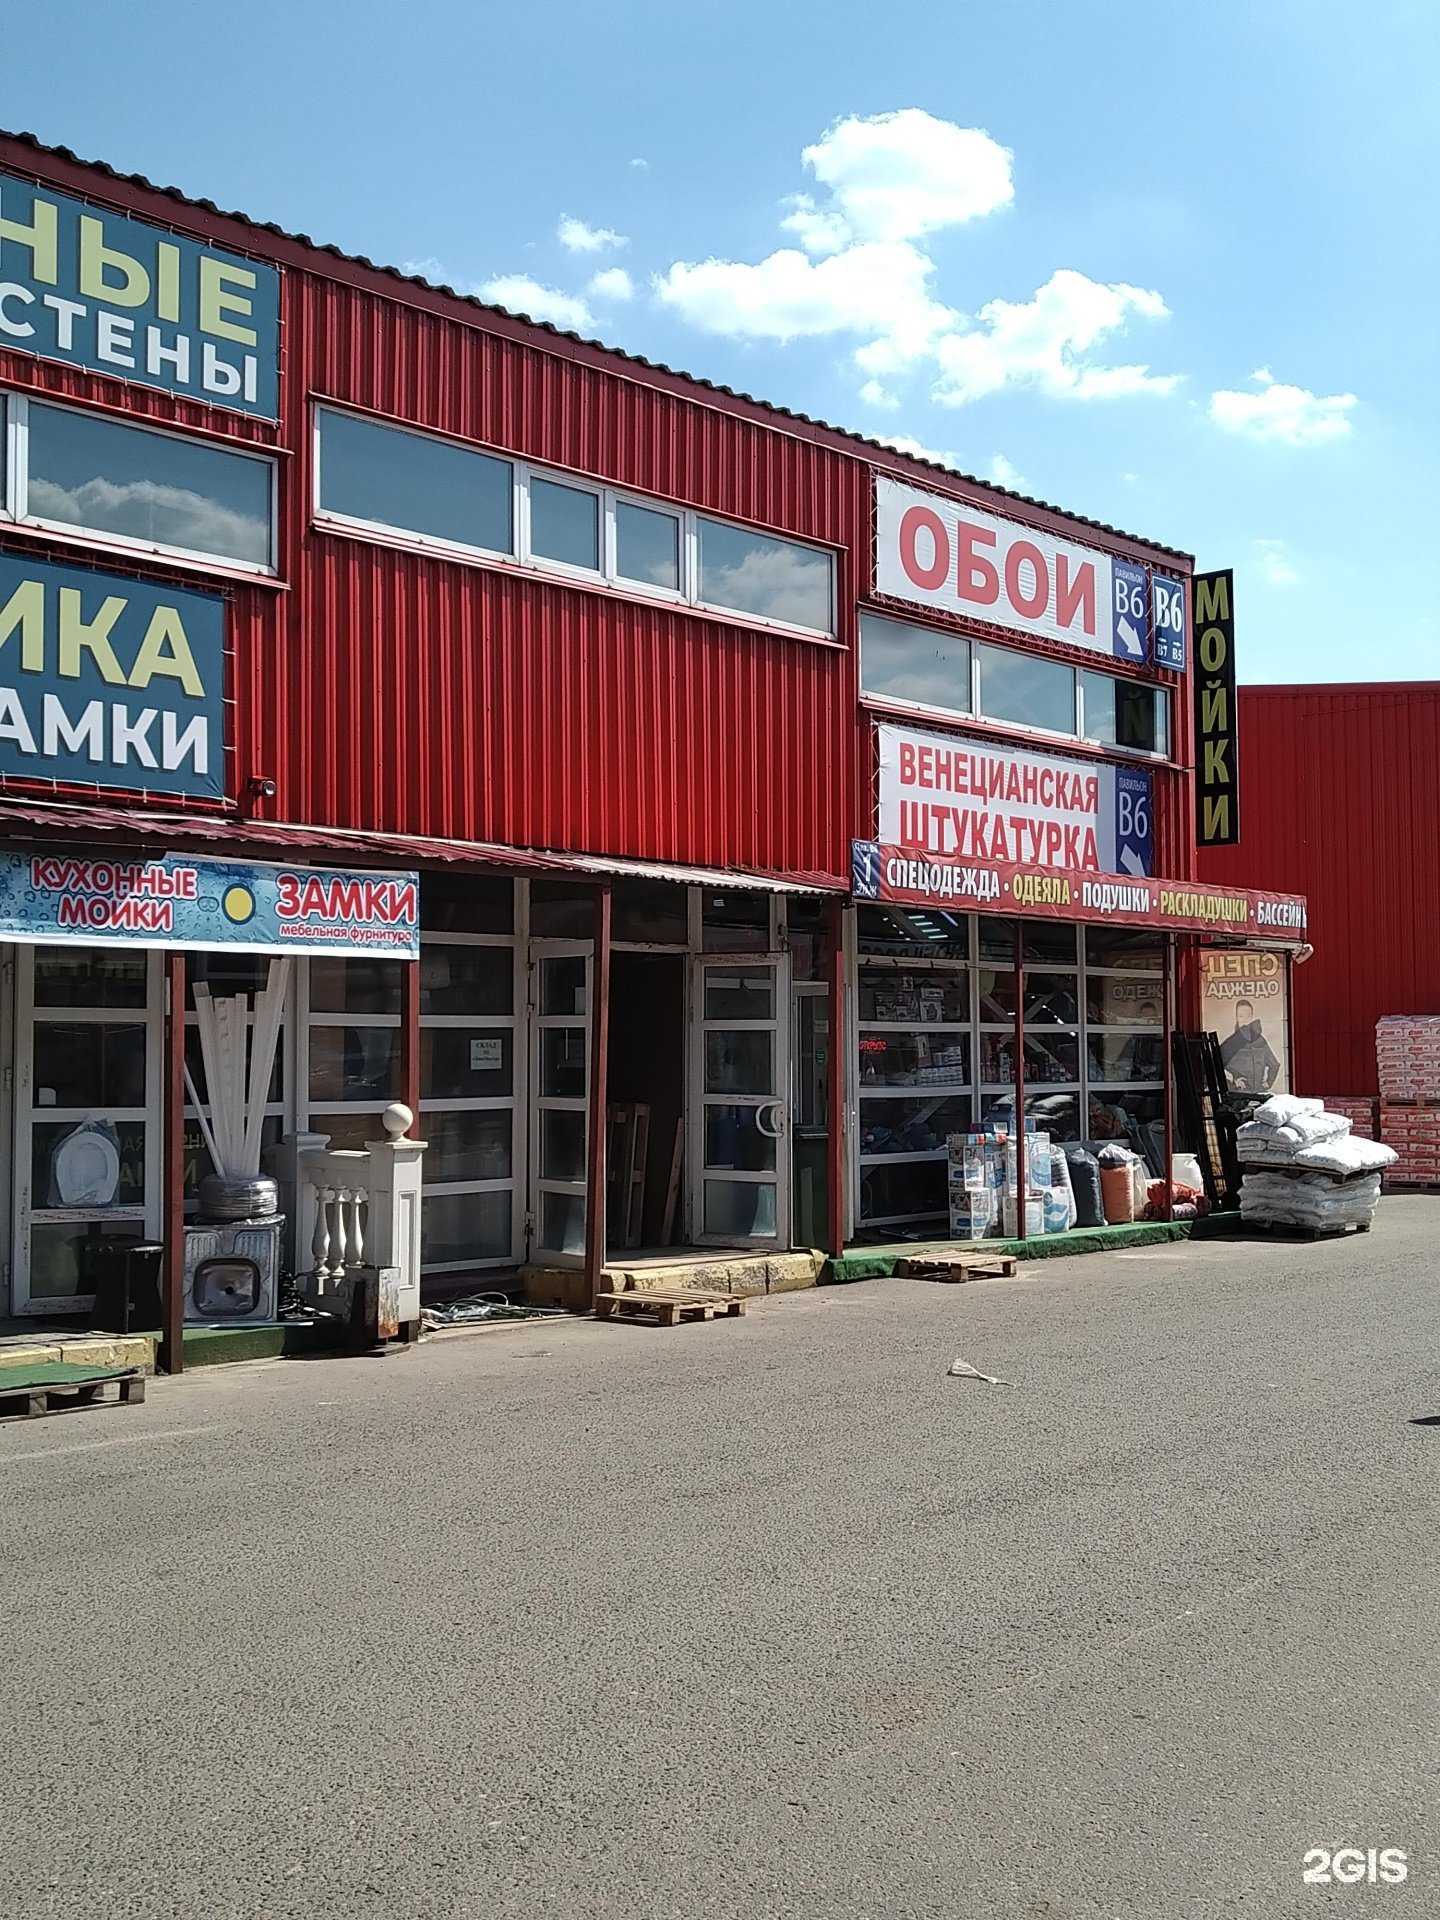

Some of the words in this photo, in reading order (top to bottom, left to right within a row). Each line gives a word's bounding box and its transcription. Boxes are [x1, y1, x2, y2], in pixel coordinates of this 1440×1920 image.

[0, 282, 257, 403] СТЕНЫ
[899, 505, 1096, 636] ОБОИ
[1115, 578, 1144, 619] В6
[1155, 585, 1183, 633] В6
[1195, 576, 1231, 841] МОЙКИ
[900, 742, 1099, 815] ВЕНЕЦИАНСКАЯ
[900, 799, 1099, 872] ШТУКАТУРКА
[1119, 791, 1148, 839] В6
[32, 857, 197, 898] КУХОННЫЕ
[275, 873, 416, 924] ЗАМКИ
[886, 859, 1000, 902] СПЕЦОДЕЖДА
[1012, 874, 1071, 906] ОДЕЯЛА
[1082, 881, 1150, 914] ПОДУШКИ
[1160, 890, 1248, 923] РАСКЛАДУШКИ
[58, 890, 174, 931] МОЙКИ
[281, 923, 347, 938] мебельная
[350, 924, 412, 943] фурнитура
